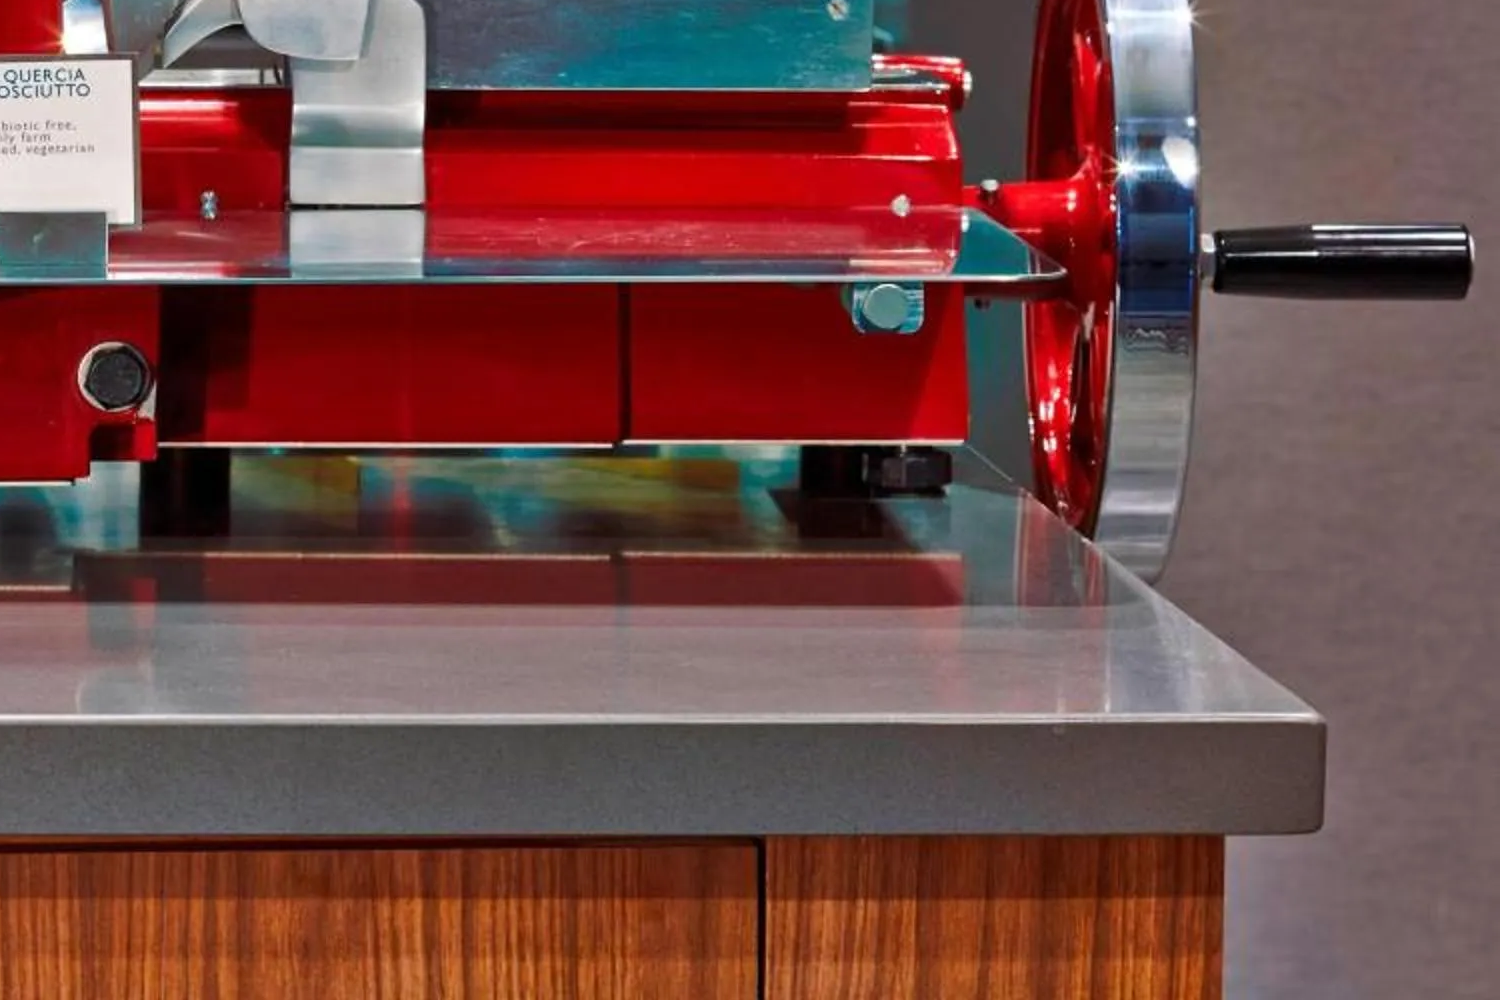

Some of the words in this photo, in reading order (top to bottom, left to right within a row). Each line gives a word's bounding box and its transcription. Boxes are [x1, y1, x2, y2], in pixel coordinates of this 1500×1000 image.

[3, 68, 86, 84] QUERCIA
[45, 120, 77, 132] free,
[21, 132, 51, 143] farm
[26, 144, 95, 157] vegetarian
